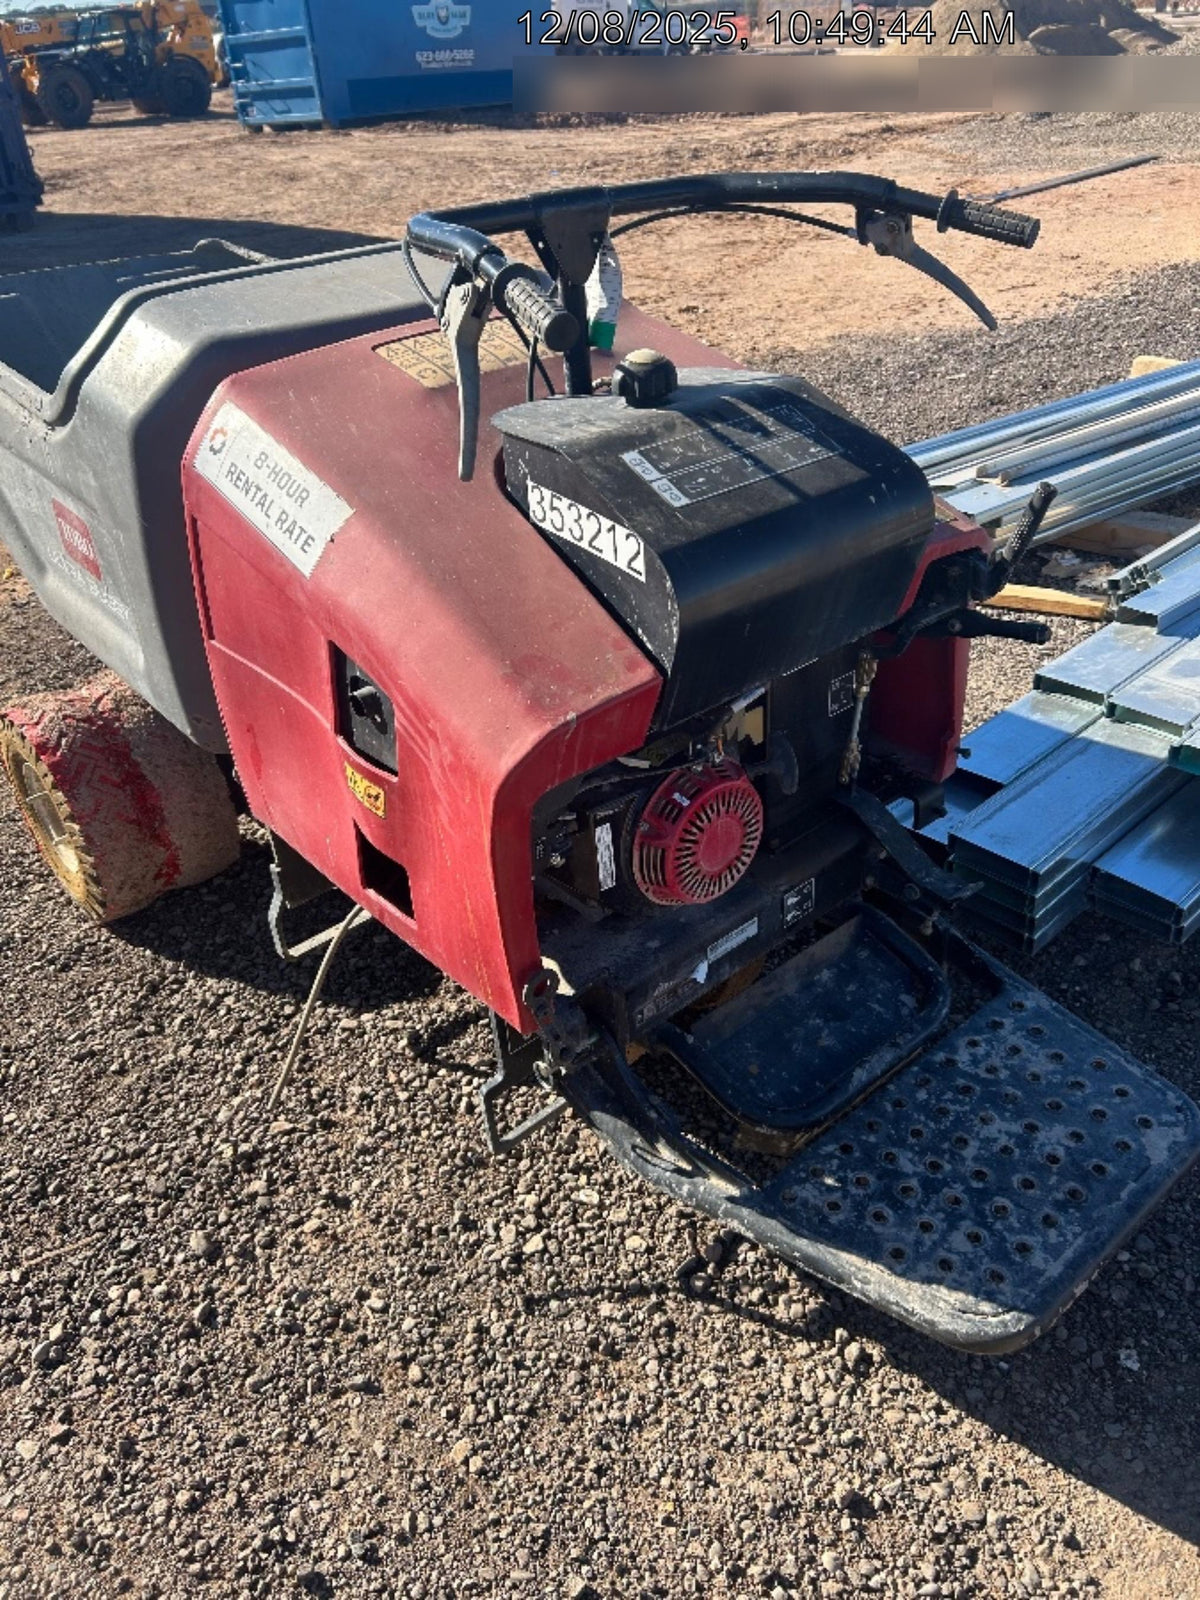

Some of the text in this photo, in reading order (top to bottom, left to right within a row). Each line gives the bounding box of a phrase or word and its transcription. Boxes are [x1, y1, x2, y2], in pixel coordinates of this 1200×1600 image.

[225, 462, 316, 554] RENTAL RATE
[253, 451, 311, 508] 8-HOUR
[530, 484, 643, 576] 353212
